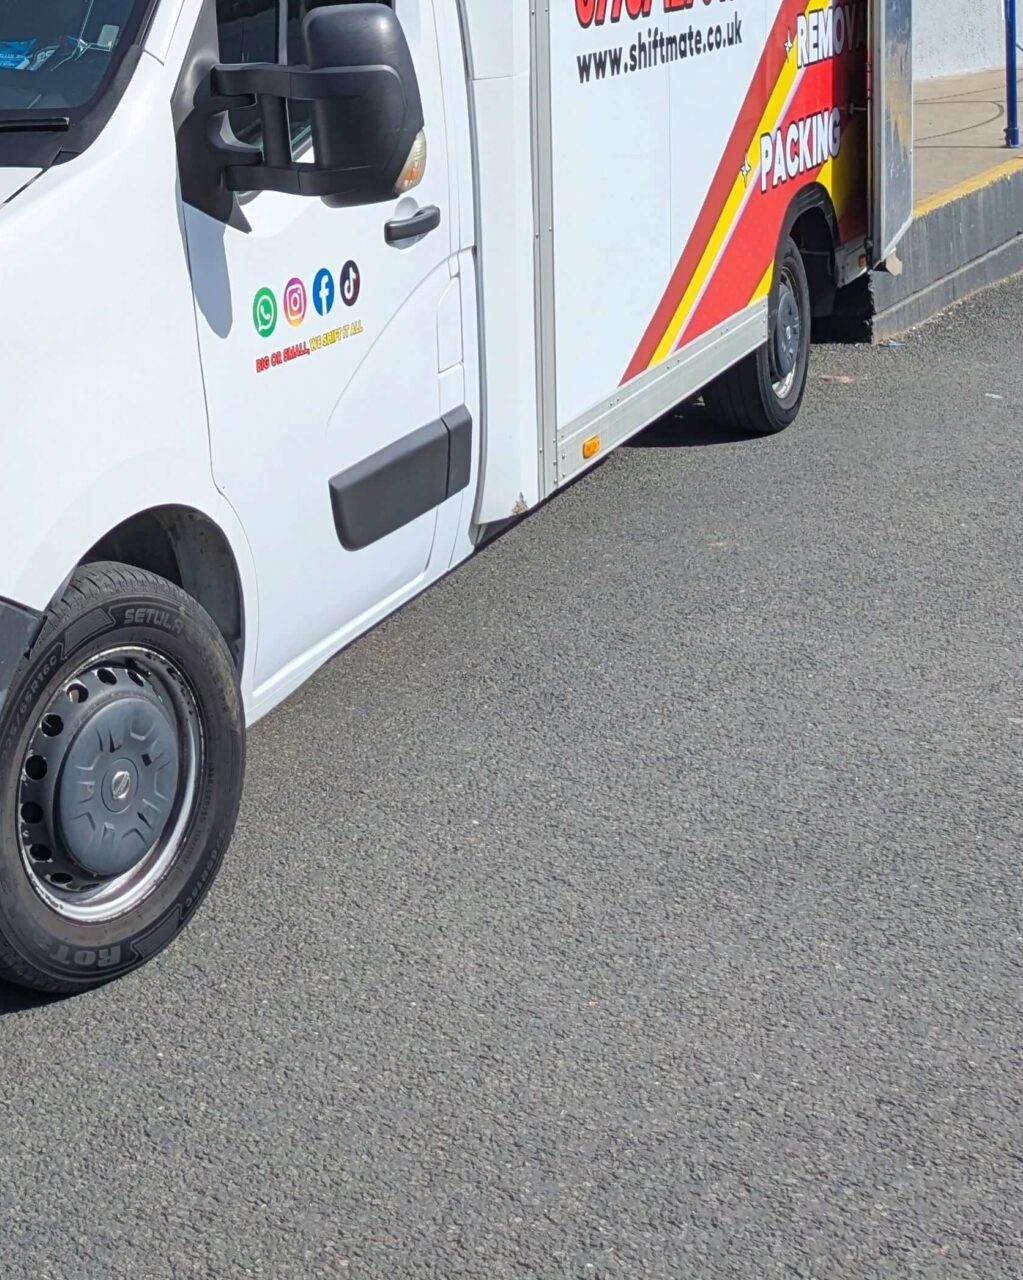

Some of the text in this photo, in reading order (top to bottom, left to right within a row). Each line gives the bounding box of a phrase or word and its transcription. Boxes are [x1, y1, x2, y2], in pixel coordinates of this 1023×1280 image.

[576, 11, 743, 84] www.shiftmate.co.uk
[760, 107, 842, 193] PACKING
[256, 320, 364, 373] BIG OR SMALL, WE SHIFT IT ALL
[124, 607, 184, 634] SETULA
